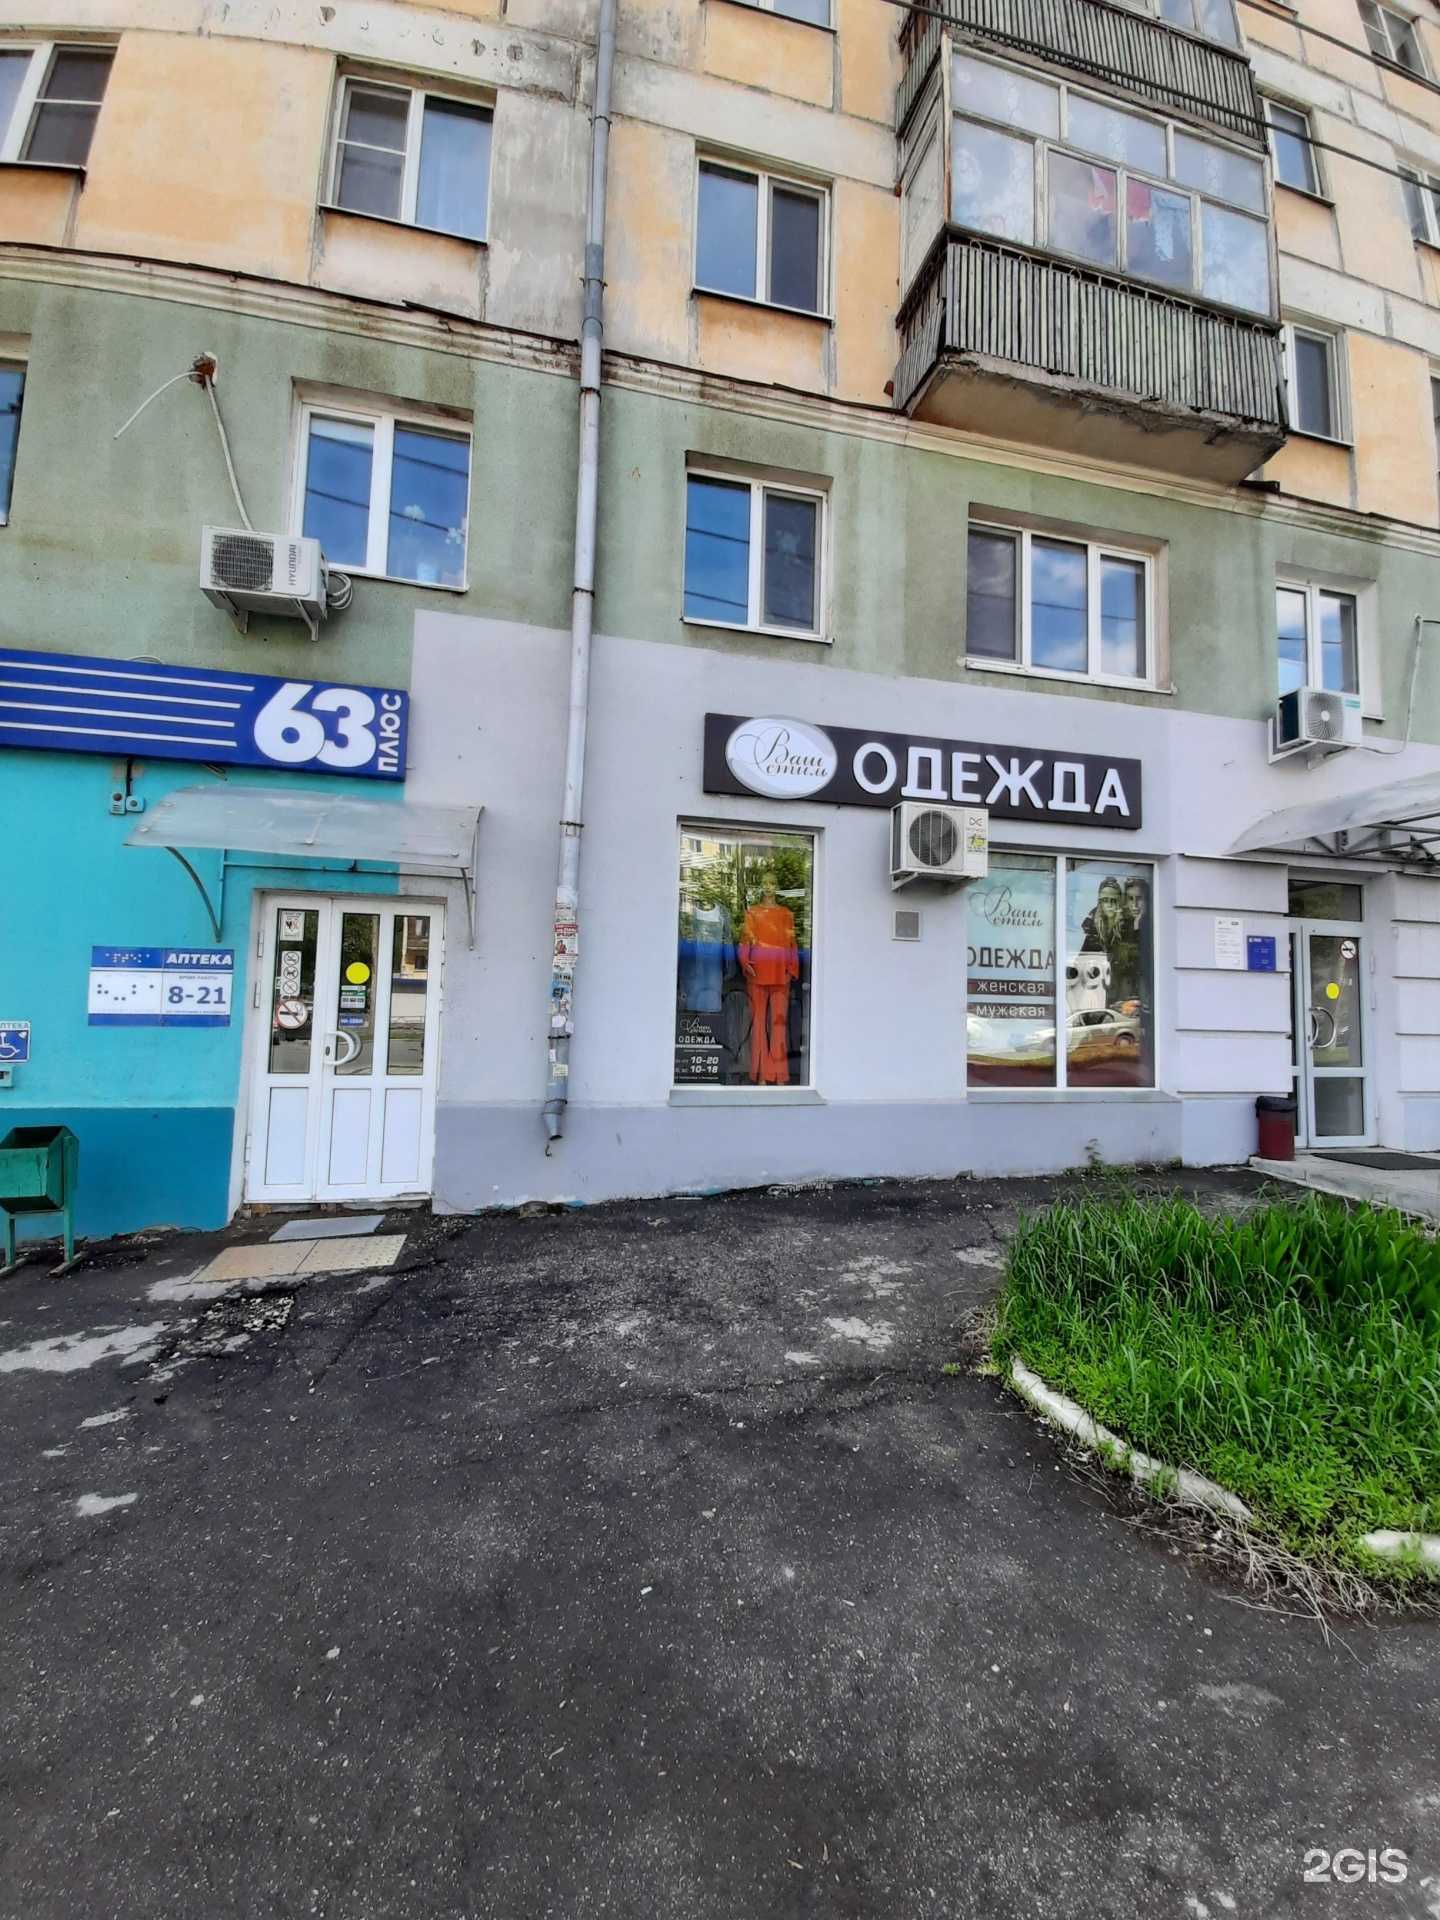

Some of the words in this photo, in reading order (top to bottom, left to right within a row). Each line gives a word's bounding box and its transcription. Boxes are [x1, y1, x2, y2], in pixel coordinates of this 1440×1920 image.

[288, 544, 297, 586] HYUNDAI
[254, 682, 377, 768] 63
[377, 693, 402, 772] ПЛЮС
[735, 727, 823, 768] Ваш
[765, 764, 829, 777] стиль
[853, 742, 1131, 816] ОДЕЖДА
[969, 885, 1040, 919] Ваш
[166, 953, 232, 966] АПТЕКА
[976, 980, 1046, 993] женская
[168, 985, 227, 1005] 8-21
[976, 1004, 1046, 1019] мужская
[0, 1022, 29, 1030] ПТЕКА
[678, 1036, 716, 1044] ОДЕЖДА
[690, 1056, 719, 1064] 10-20
[690, 1065, 718, 1073] 10-18
